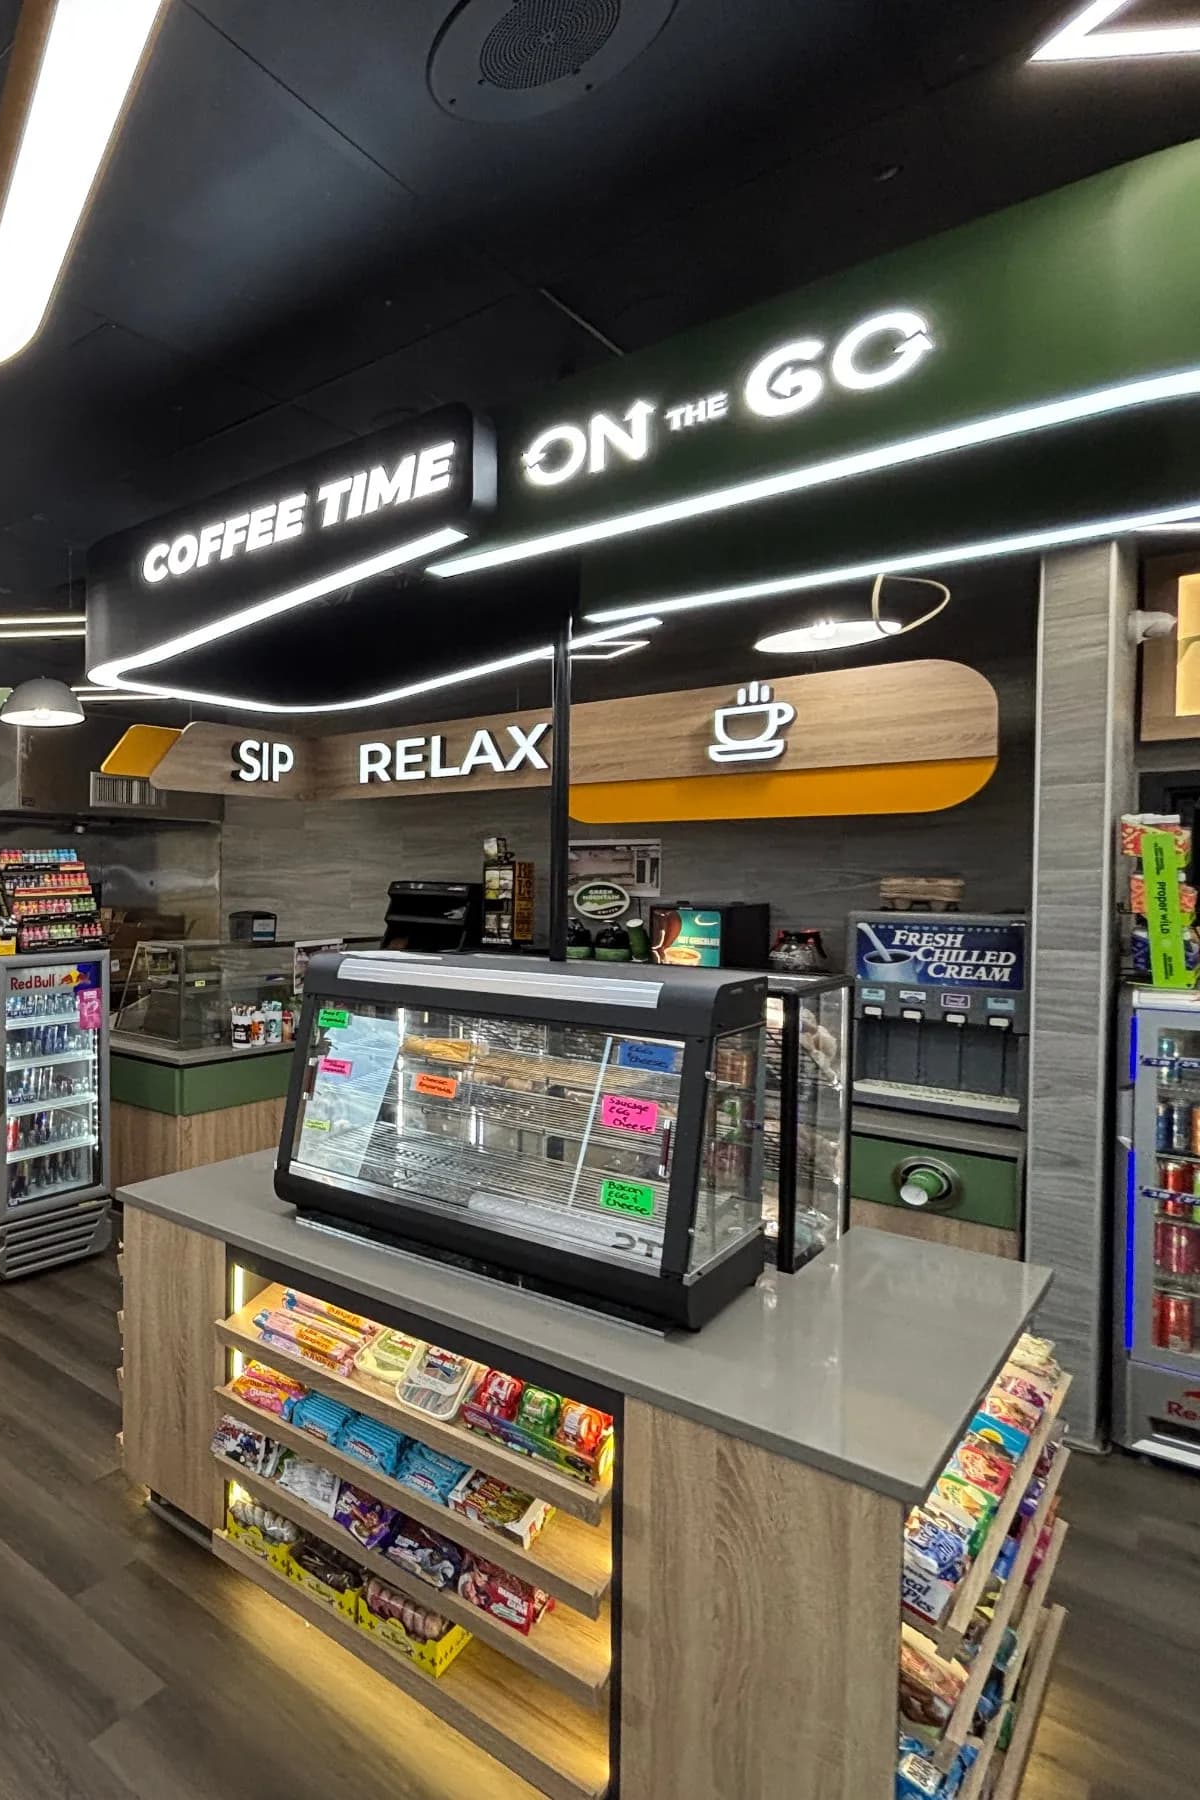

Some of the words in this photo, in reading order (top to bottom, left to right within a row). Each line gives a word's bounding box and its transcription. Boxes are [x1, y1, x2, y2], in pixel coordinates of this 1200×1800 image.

[522, 399, 656, 486] ON
[664, 392, 729, 431] THE
[745, 310, 935, 417] GO
[141, 492, 309, 585] COFFEE
[314, 440, 457, 530] TIME
[237, 740, 295, 783] SIP
[359, 723, 551, 784] RELAX
[892, 929, 965, 948] FRESH
[916, 946, 1017, 966] CHILLED
[10, 975, 33, 990] Red
[34, 973, 56, 988] Bull
[927, 962, 1012, 982] CREAM
[1167, 1400, 1200, 1421] Re
